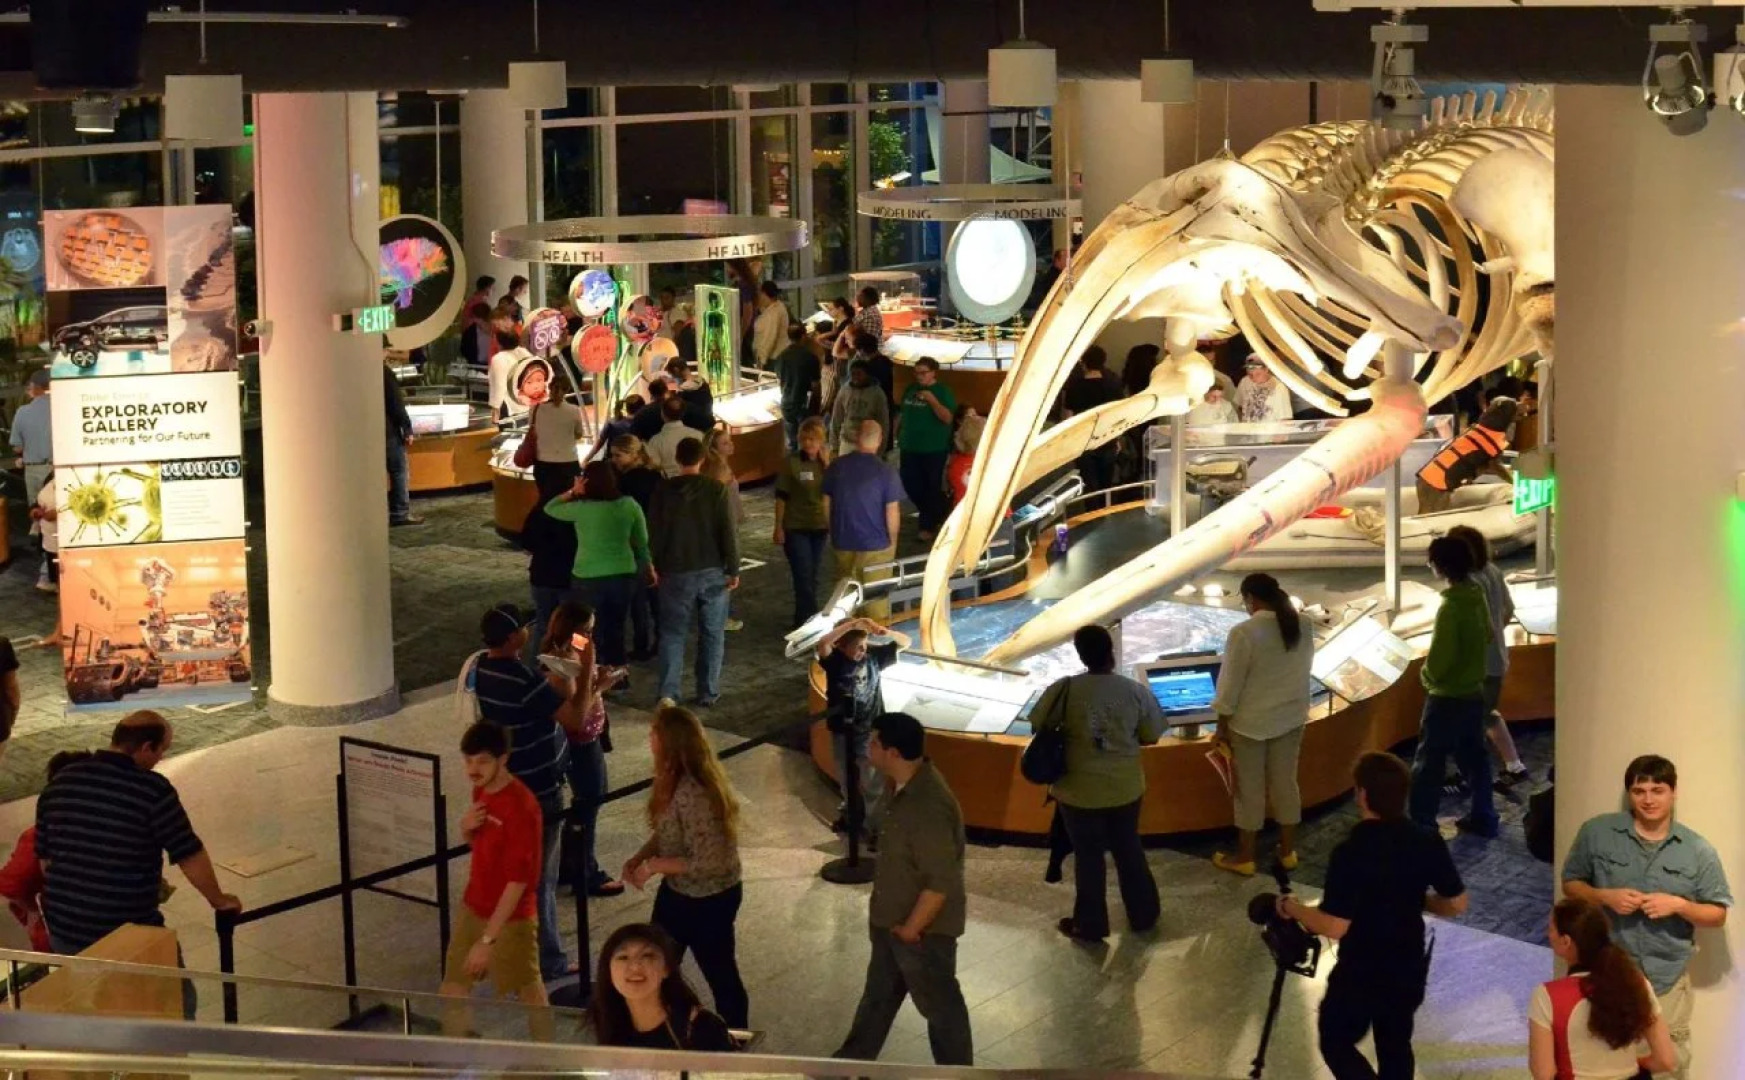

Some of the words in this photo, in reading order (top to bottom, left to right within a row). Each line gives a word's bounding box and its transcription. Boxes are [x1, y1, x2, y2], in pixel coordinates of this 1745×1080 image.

[541, 250, 603, 262] HEALTH
[708, 242, 766, 258] HEALTH
[363, 306, 390, 333] EXIT
[82, 401, 208, 419] EXPLORATORY
[82, 417, 158, 433] GALLERY
[83, 435, 135, 446] Partnering
[138, 433, 152, 443] for
[155, 433, 174, 442] Our
[177, 431, 211, 441] Future
